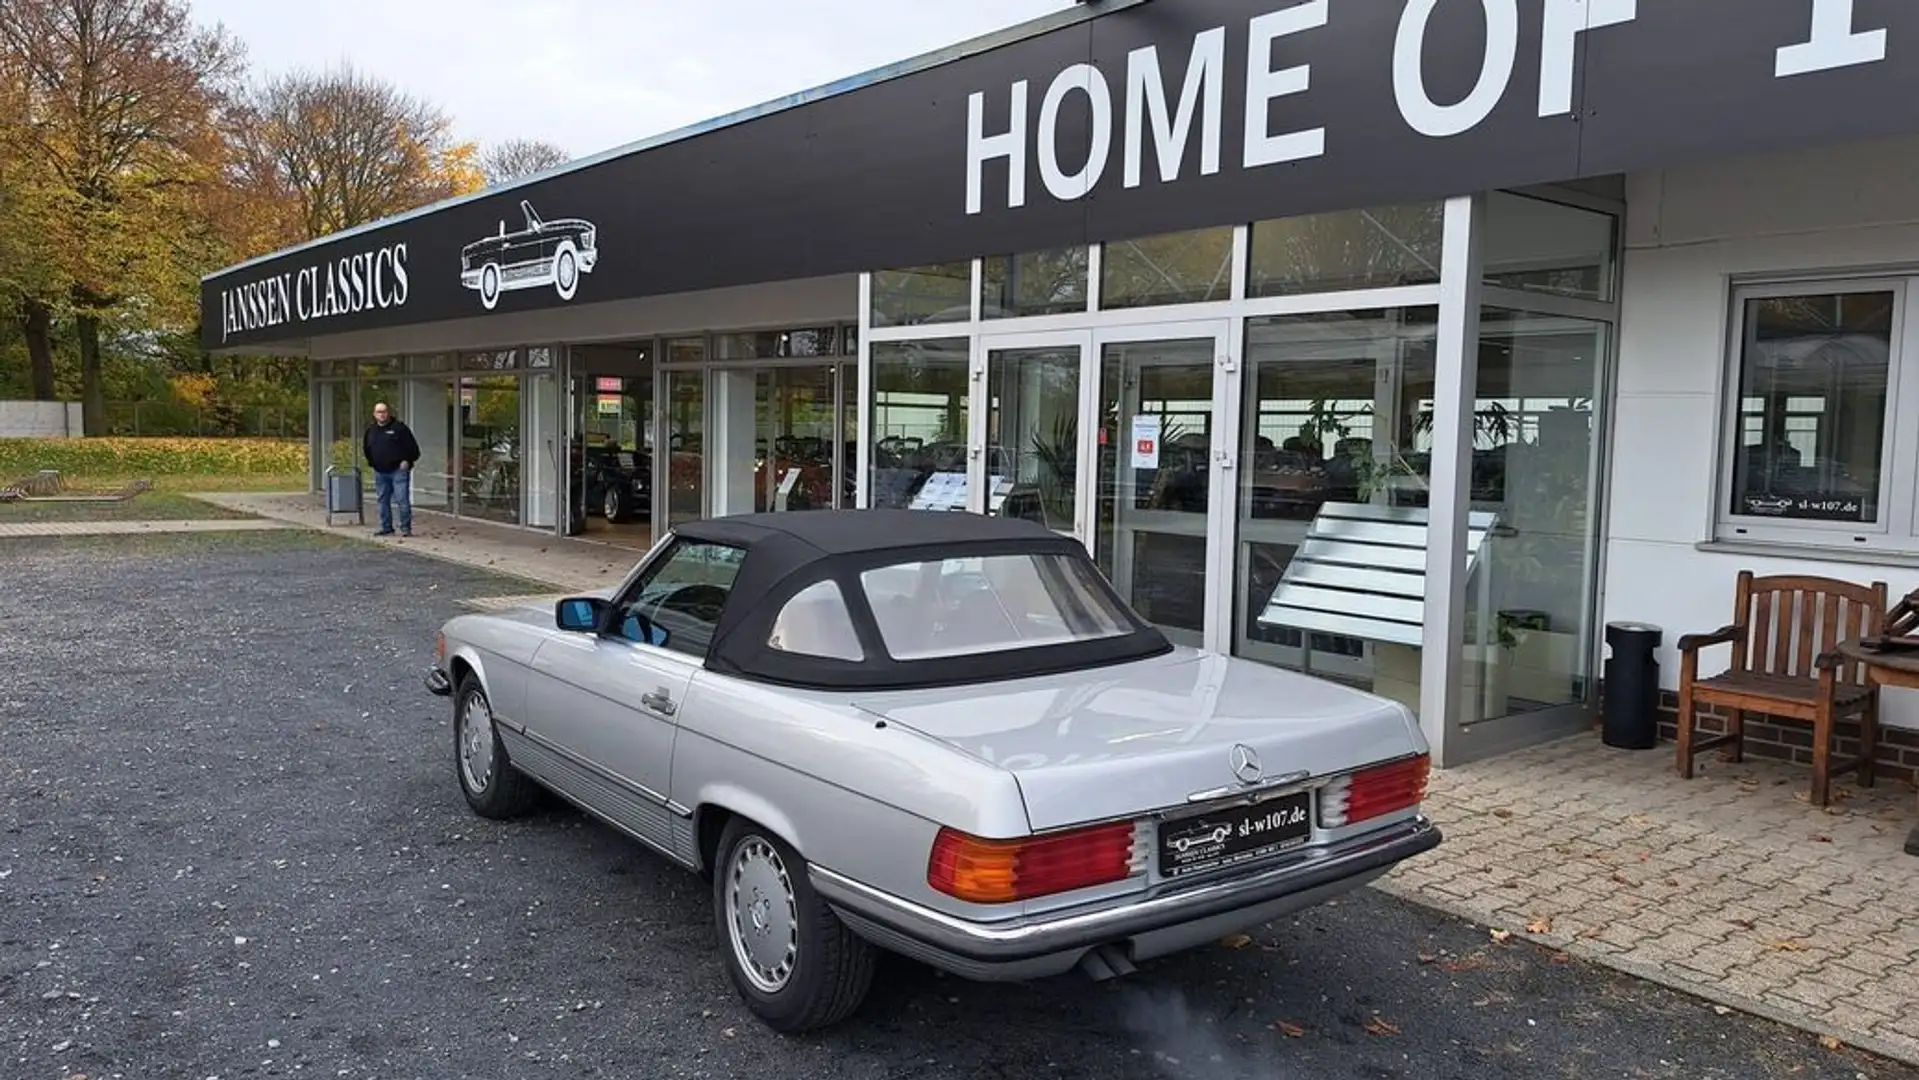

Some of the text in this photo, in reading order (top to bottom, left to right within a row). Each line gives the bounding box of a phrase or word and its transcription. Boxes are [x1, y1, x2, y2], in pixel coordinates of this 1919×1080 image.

[966, 0, 1328, 214] HOME
[222, 243, 408, 343] JANSSEN CLASSICS
[1239, 806, 1306, 837] sl-w107.de
